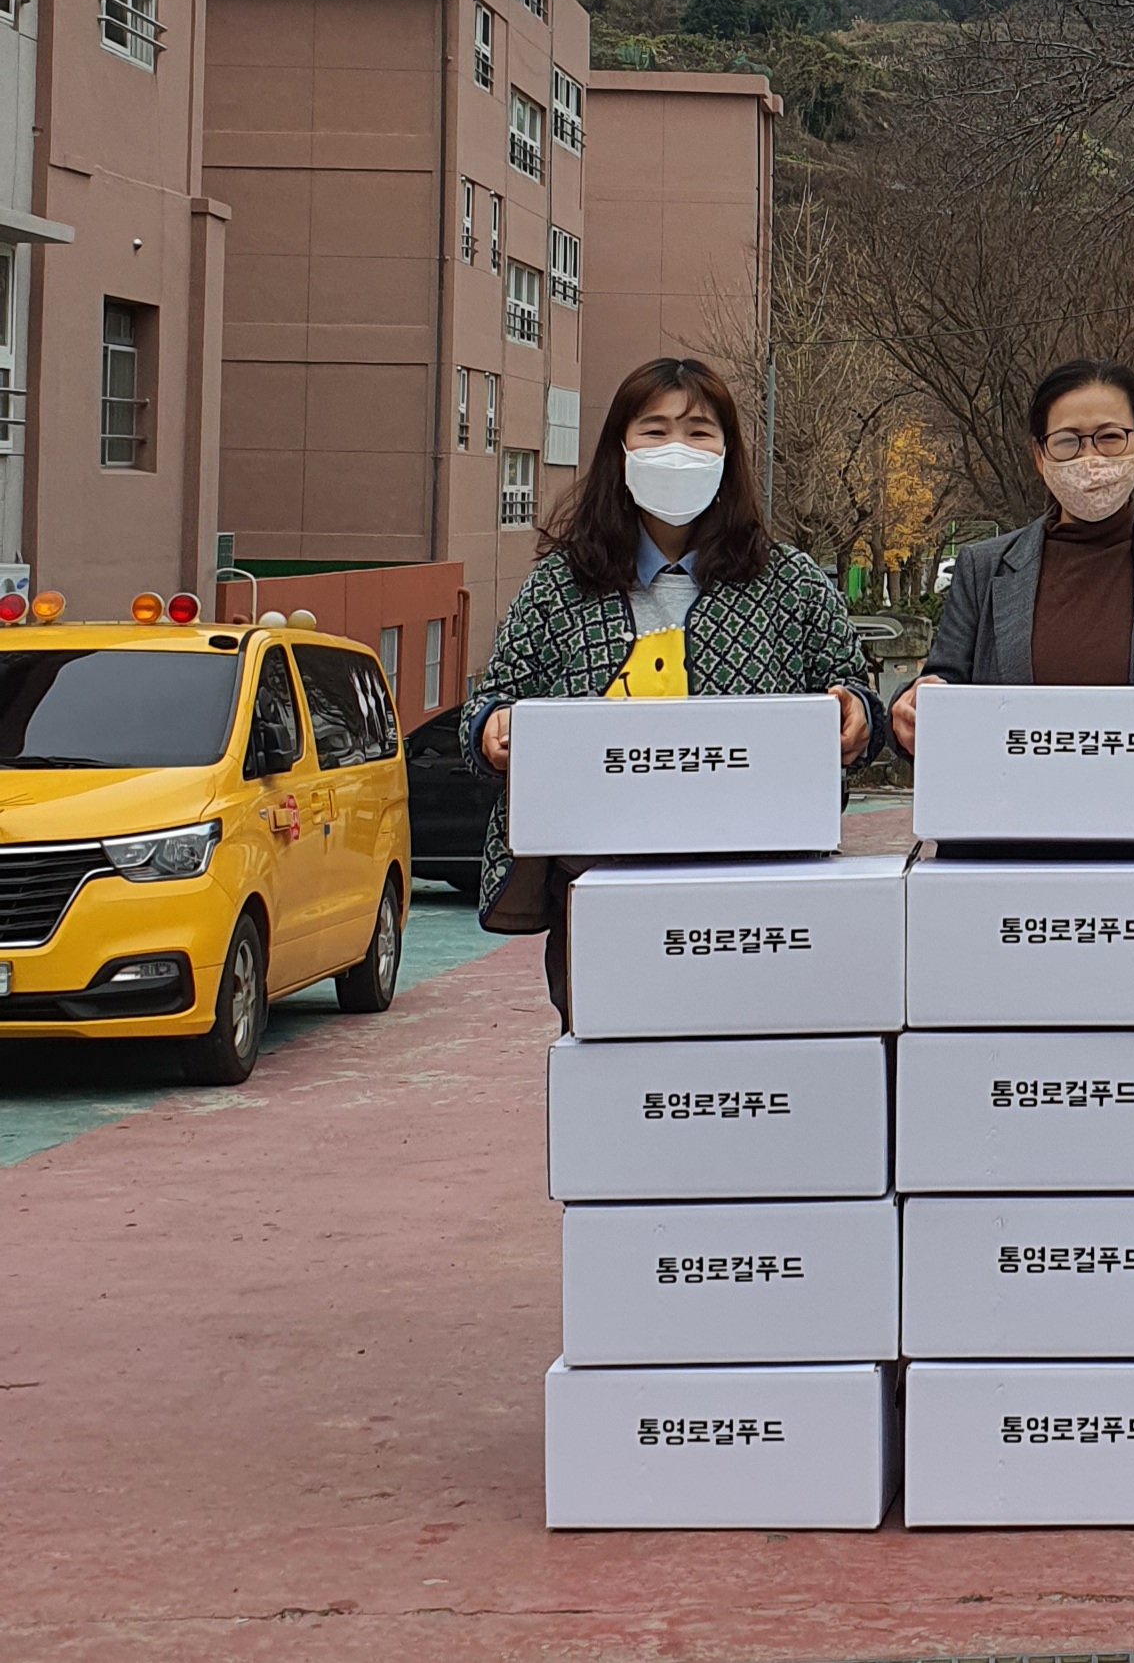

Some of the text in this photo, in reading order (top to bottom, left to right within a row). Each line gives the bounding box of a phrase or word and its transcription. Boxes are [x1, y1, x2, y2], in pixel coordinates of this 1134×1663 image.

[603, 746, 751, 775] 통영로컬푸드
[663, 927, 813, 957] 통영로컬푸드
[642, 1091, 792, 1121] 통영로컬푸드
[656, 1255, 806, 1285] 통영로컬푸드
[637, 1418, 786, 1447] 통영로컬푸드
